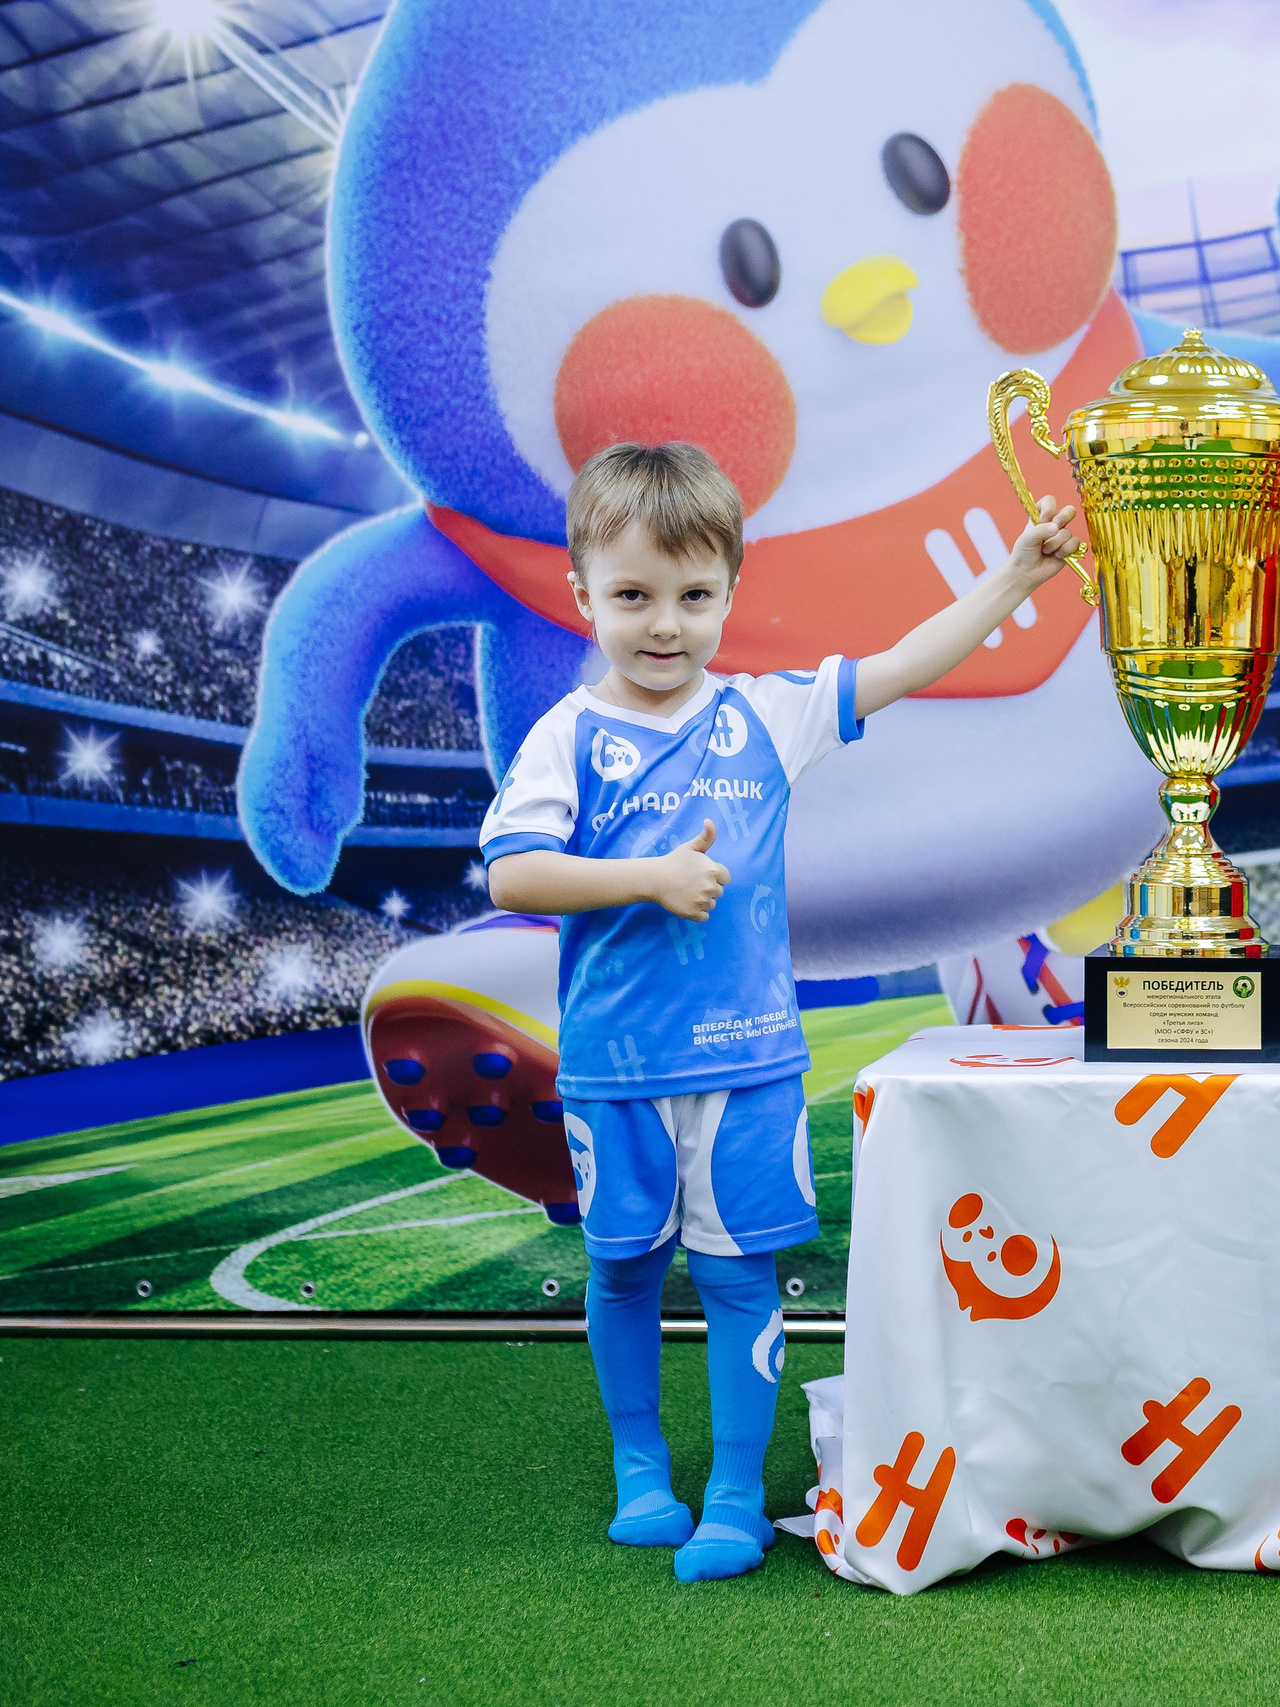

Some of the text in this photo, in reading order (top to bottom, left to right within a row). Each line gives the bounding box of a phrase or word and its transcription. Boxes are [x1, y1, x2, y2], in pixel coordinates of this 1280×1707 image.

[622, 778, 764, 816] НАДЖДИК
[1142, 980, 1224, 993] ПОБЕДИТЕЛЬ
[1122, 1001, 1167, 1009] Всероссийских
[1220, 1002, 1246, 1010] футболу
[692, 1018, 743, 1034] ВПЕРЁД
[744, 1017, 753, 1027] К
[693, 1030, 744, 1046] ВМЕСТЕ
[745, 1027, 762, 1039] МЫ
